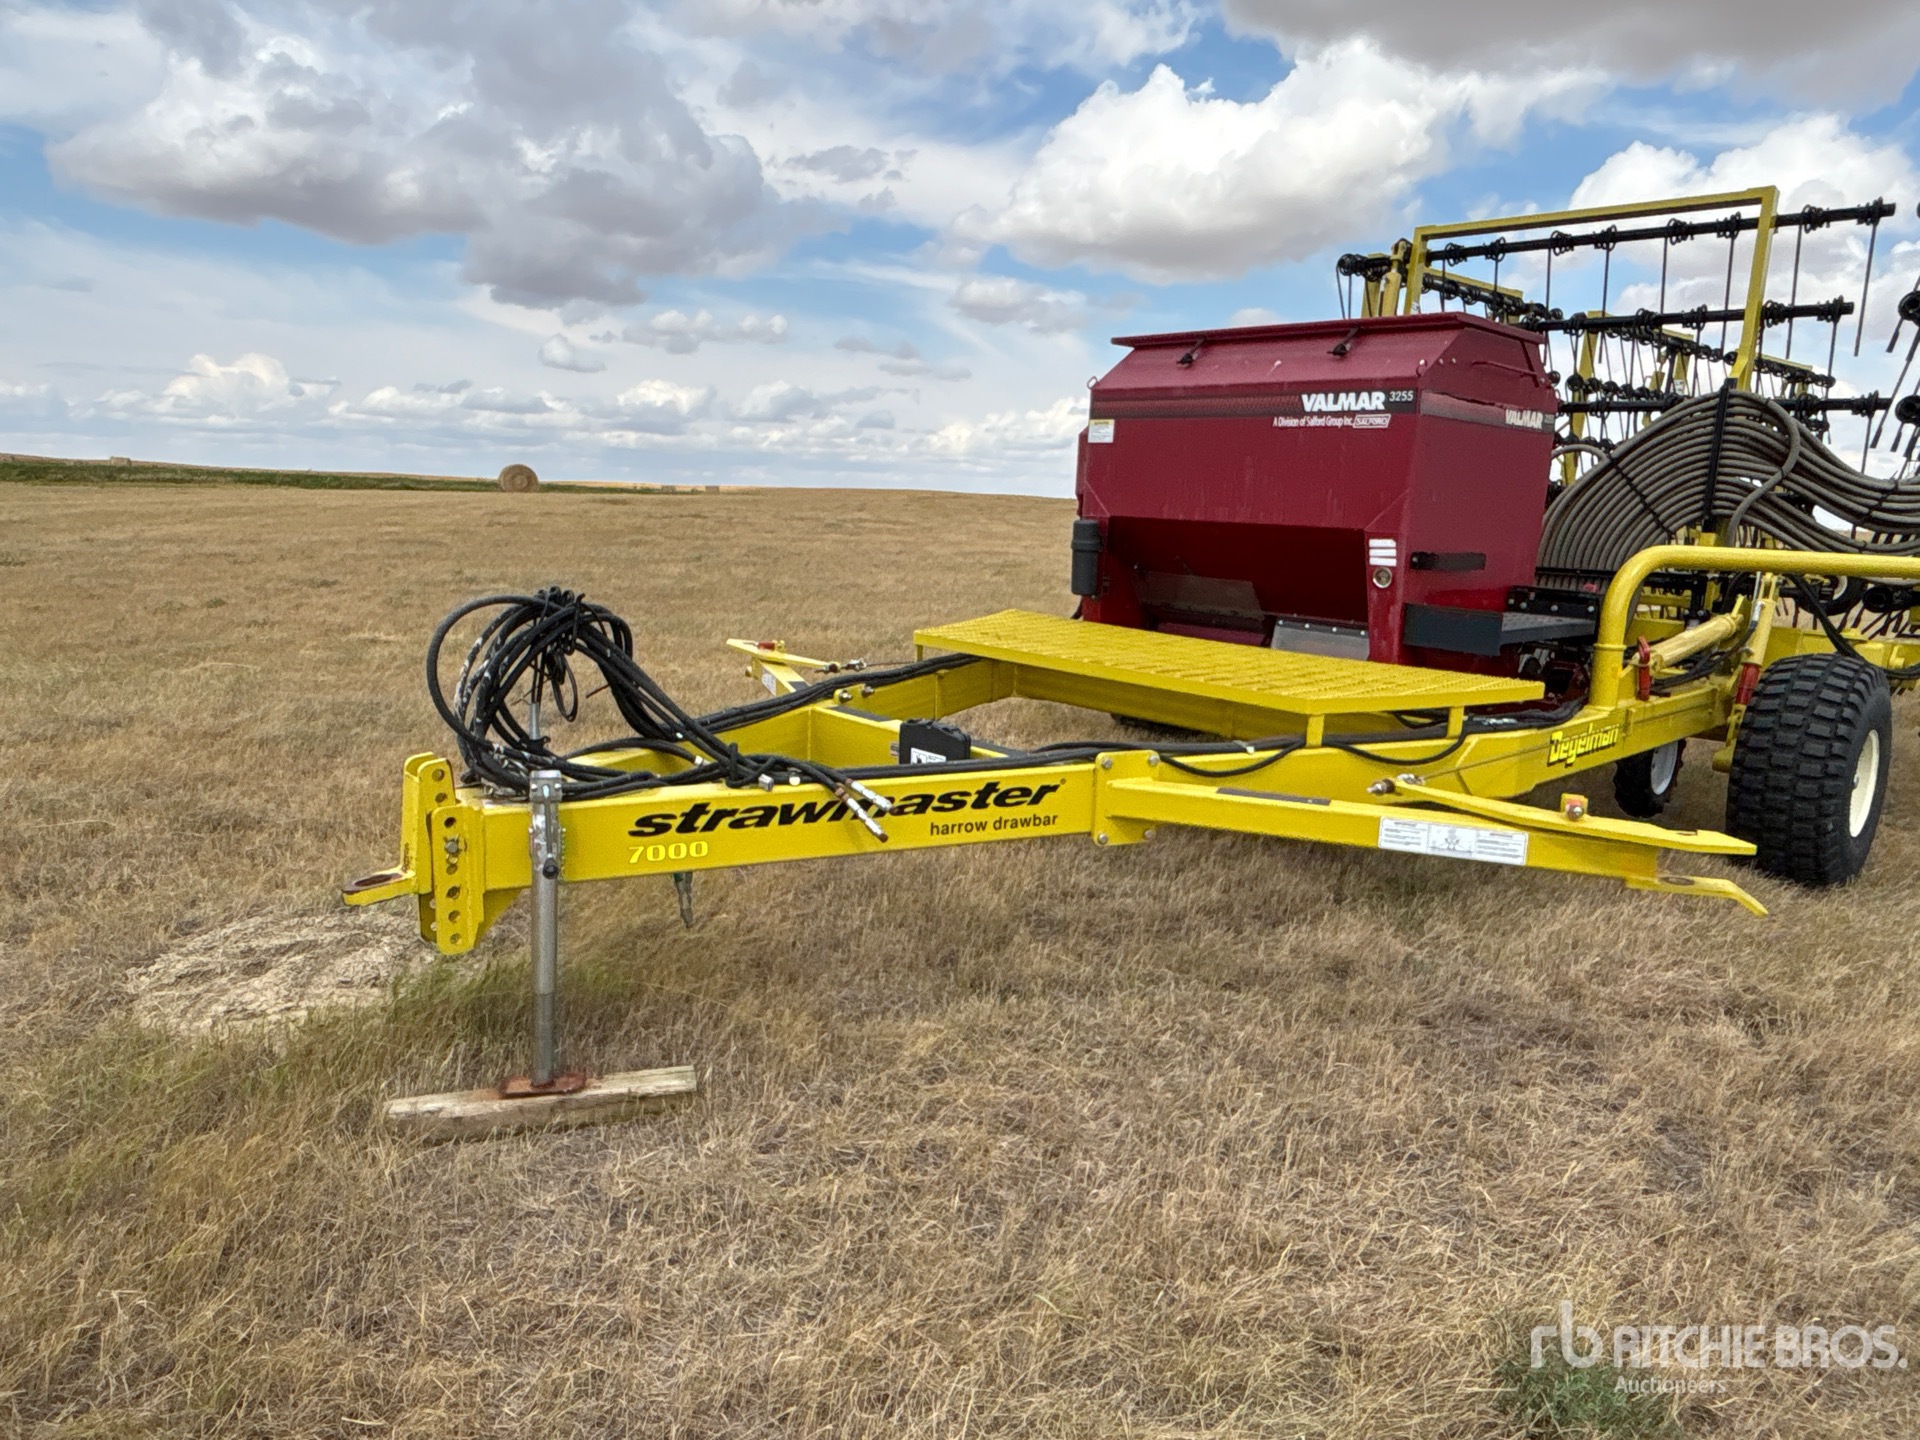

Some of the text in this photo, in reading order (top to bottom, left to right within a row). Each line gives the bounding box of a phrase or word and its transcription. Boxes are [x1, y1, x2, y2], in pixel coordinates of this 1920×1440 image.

[1301, 390, 1414, 412] VALMAR 3255
[1272, 416, 1277, 427] A
[1278, 416, 1299, 427] Division
[1505, 408, 1544, 430] VALMAR
[1548, 723, 1619, 767] Degelman
[930, 813, 1058, 836] harrow drawbar
[628, 840, 709, 864] 7000
